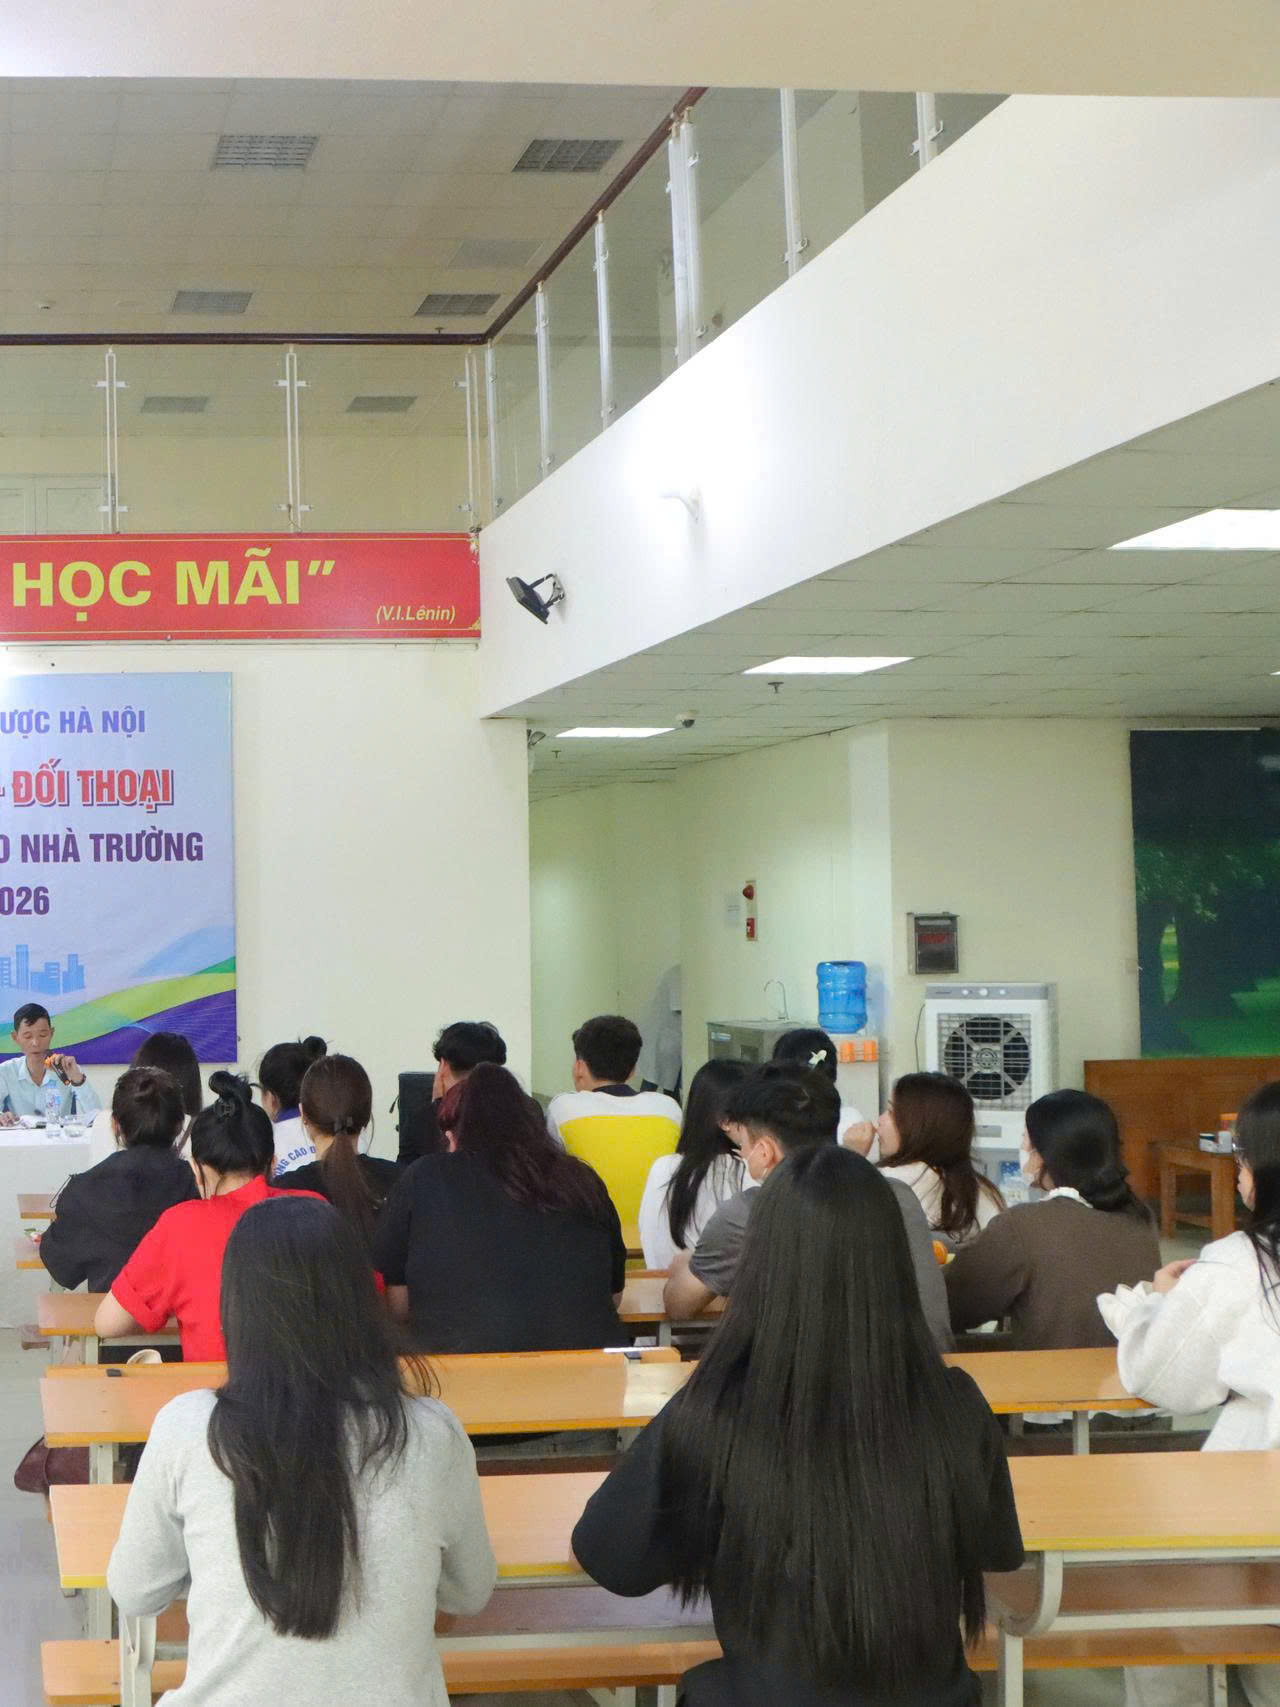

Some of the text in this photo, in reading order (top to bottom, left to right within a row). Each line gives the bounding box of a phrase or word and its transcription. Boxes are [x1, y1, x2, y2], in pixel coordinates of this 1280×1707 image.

[12, 561, 153, 622] HỌC
[375, 603, 457, 625] (V.I.Lênin)
[59, 706, 94, 733] HÀ
[102, 705, 146, 738] NỘI
[12, 758, 70, 808] ĐỐI
[77, 768, 174, 814] THOẠI
[20, 827, 81, 864] NHÀ
[89, 825, 204, 862] TRƯỜNG
